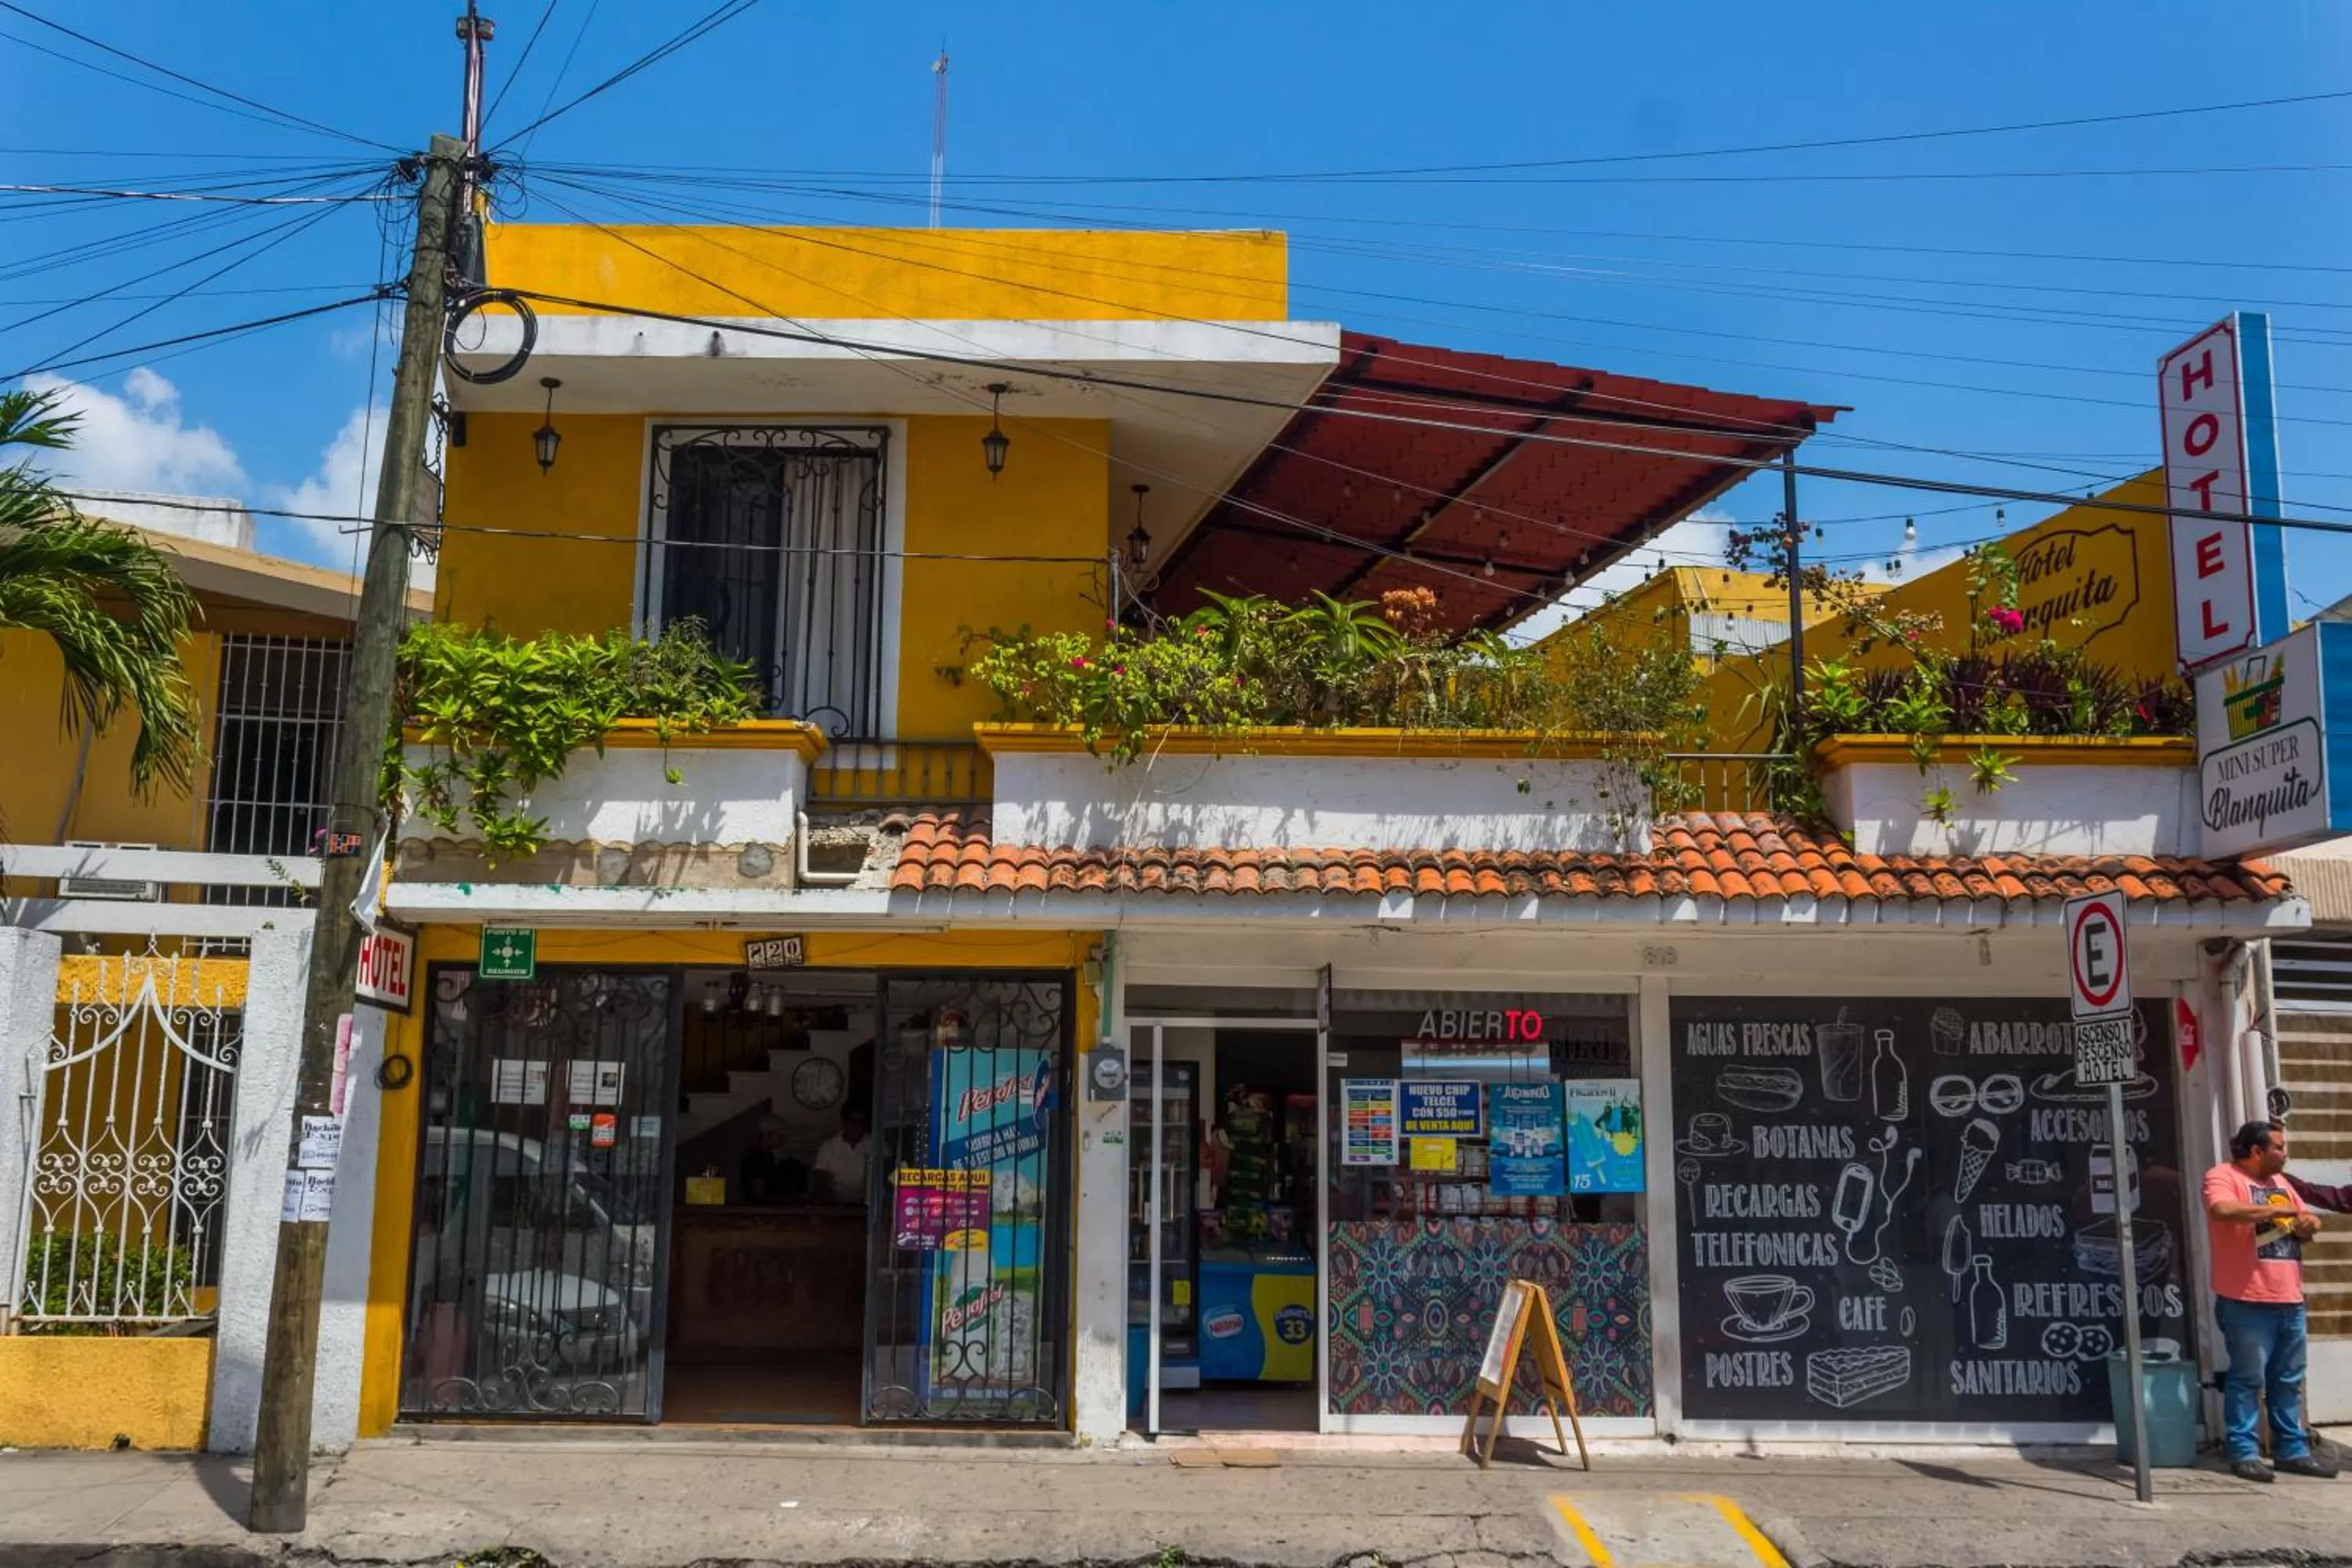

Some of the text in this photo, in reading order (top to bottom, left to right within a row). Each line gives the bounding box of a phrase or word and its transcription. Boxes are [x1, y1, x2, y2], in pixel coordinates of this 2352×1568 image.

[2183, 350, 2228, 640] HOTEL
[2017, 534, 2076, 585] Hotel
[2217, 735, 2299, 783] MINI SUPER
[2209, 765, 2313, 838] Blanquita
[358, 933, 405, 997] HOTEL
[2085, 921, 2110, 988] E
[1417, 1010, 1542, 1040] ABIERTO
[1687, 1022, 1812, 1056] AGUAS FRESCAS
[2078, 1023, 2120, 1044] ASCENSO
[2078, 1041, 2132, 1062] DESCENSO
[2085, 1060, 2128, 1082] HOTEL
[1409, 1084, 1471, 1095] NUEVO CHIP
[1423, 1095, 1457, 1106] TELCEL
[1412, 1107, 1435, 1118] CON
[1419, 1120, 1450, 1131] VENTA
[2031, 1108, 2151, 1142] ACCESOOS
[1752, 1125, 1857, 1159] BOTANAS
[899, 1172, 956, 1183] RECARGS
[1573, 1174, 1592, 1189] 15
[1705, 1184, 1821, 1218] RECARGAS
[1980, 1203, 2066, 1238] HELADOS
[1690, 1232, 1839, 1267] TELEFONICAS
[1838, 1295, 1888, 1330] CAFE
[1705, 1351, 1794, 1388] POSTRES
[1950, 1360, 2082, 1396] SANITARIOS
